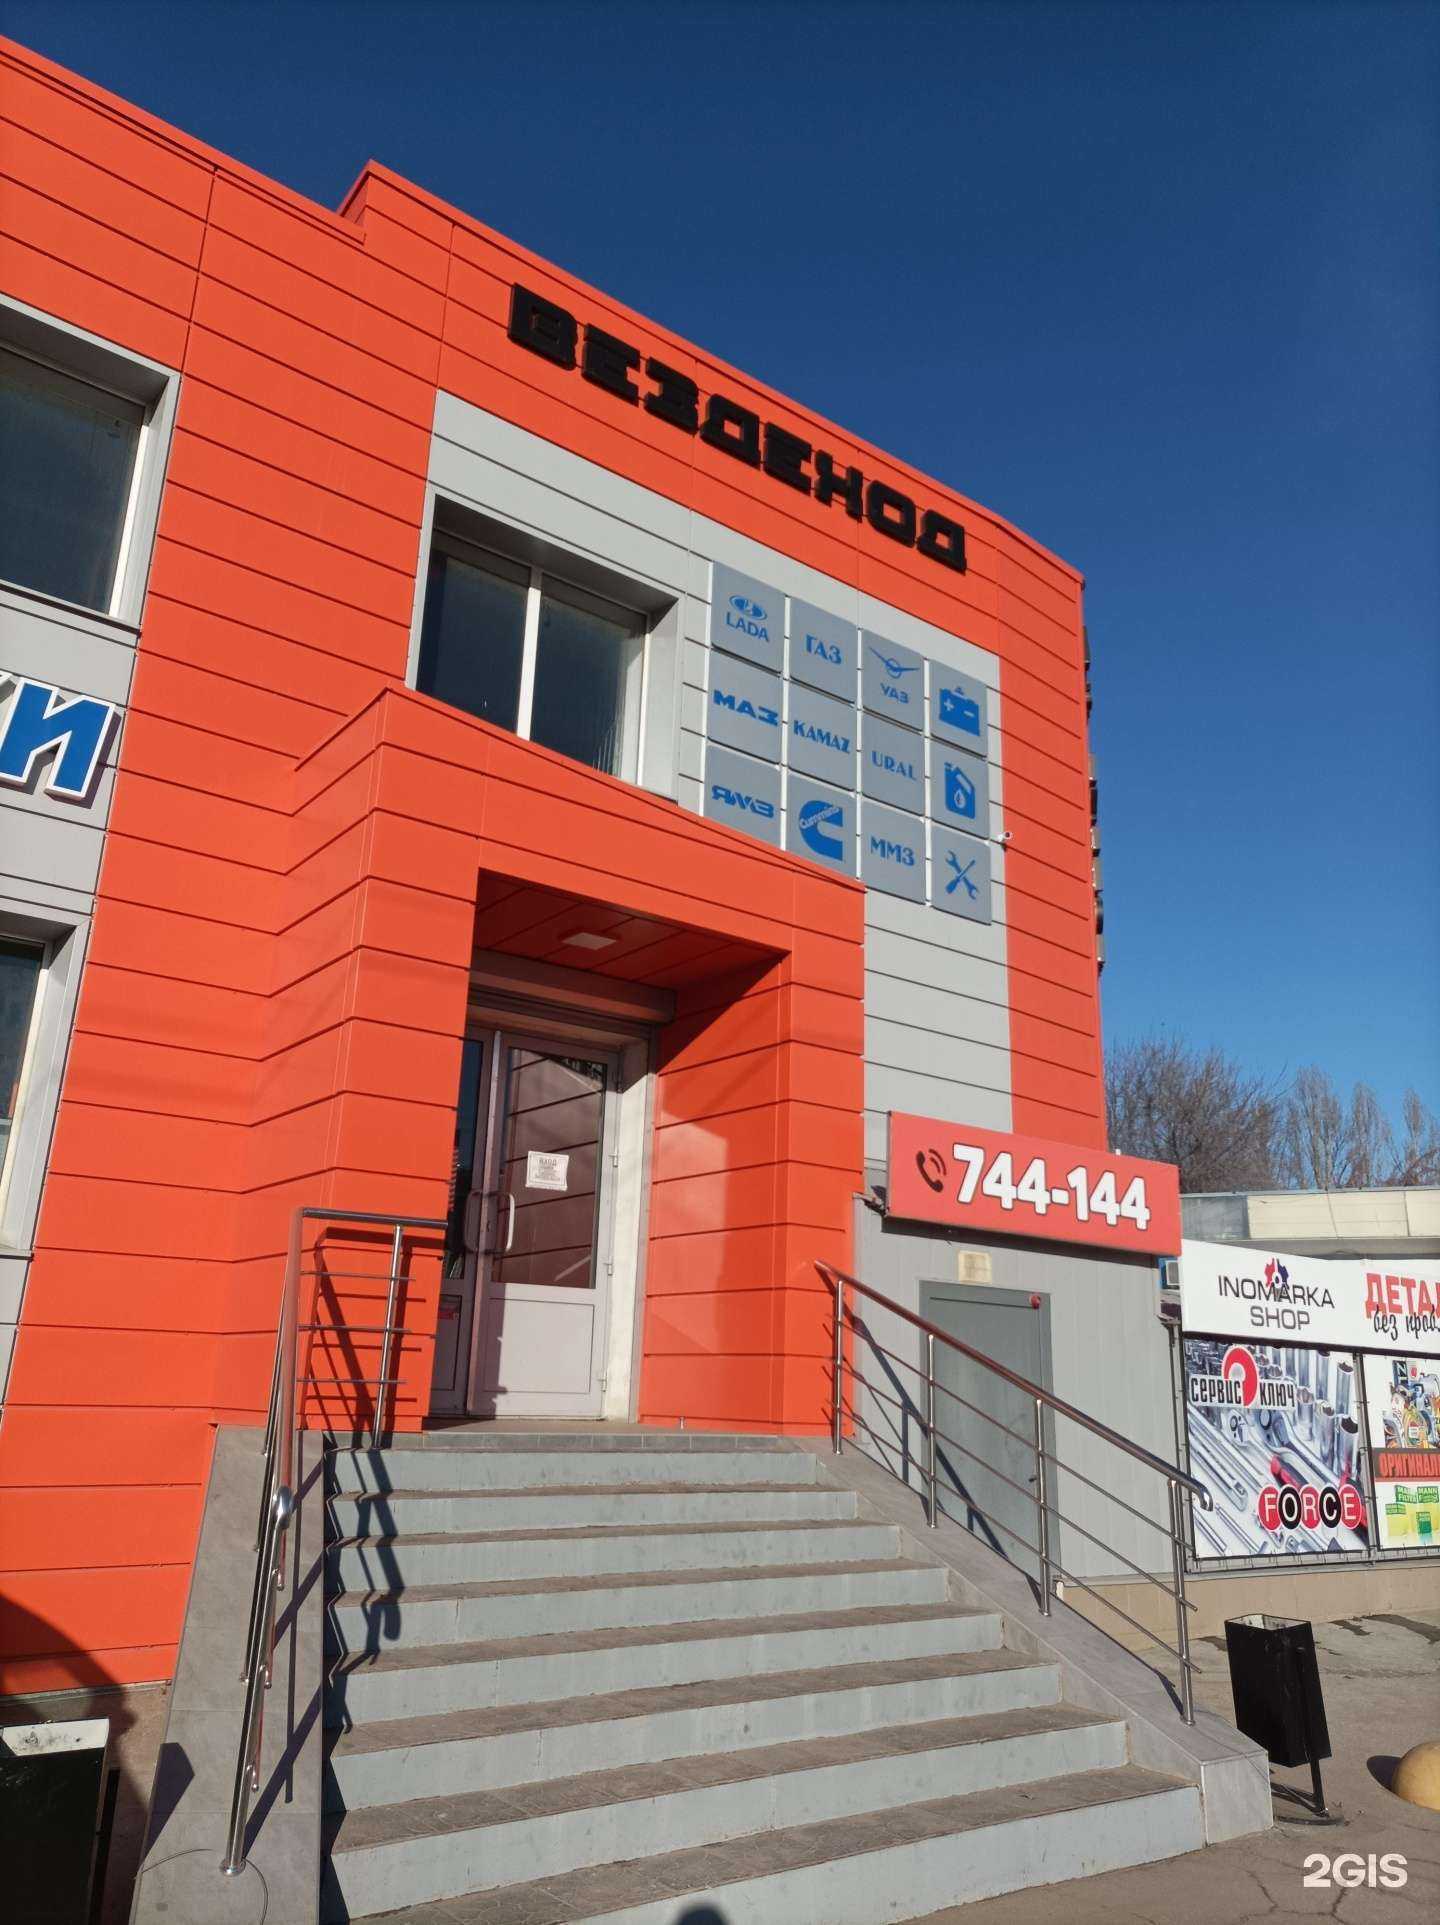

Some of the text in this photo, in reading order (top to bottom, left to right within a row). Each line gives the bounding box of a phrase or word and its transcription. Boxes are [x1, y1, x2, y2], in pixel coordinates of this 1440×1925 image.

[507, 282, 968, 576] ВЕЗДЕХОД
[725, 611, 771, 643] LADA
[805, 634, 843, 665] ГАЗ
[793, 719, 851, 754] KAMAZ
[871, 750, 917, 781] URAL
[952, 1142, 1151, 1231] 744-144
[1218, 1275, 1335, 1309] INOMARKA
[1250, 1305, 1311, 1330] SHOP
[1373, 1304, 1440, 1341] без проб
[1262, 1488, 1358, 1525] FORCE
